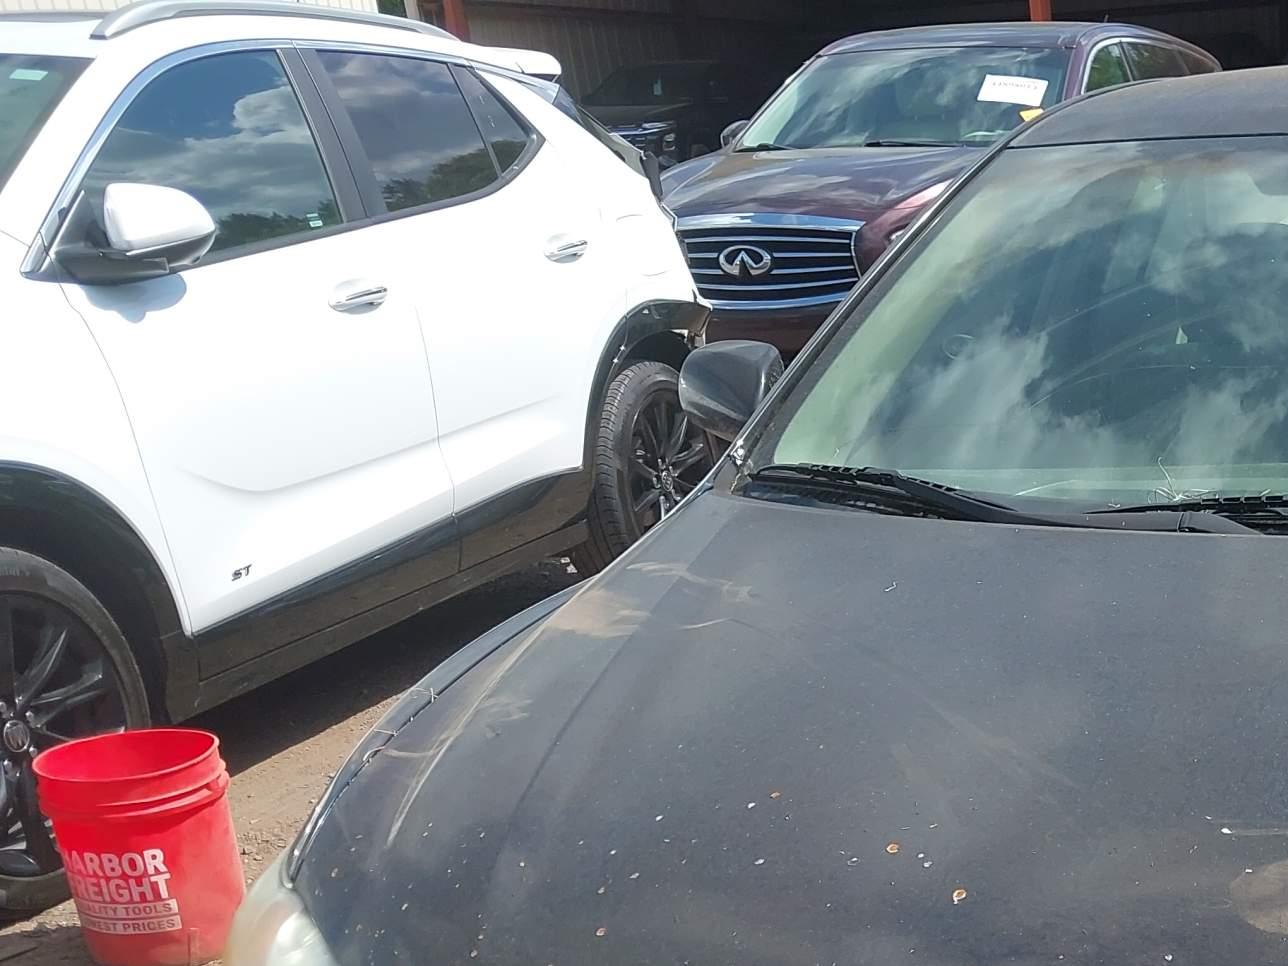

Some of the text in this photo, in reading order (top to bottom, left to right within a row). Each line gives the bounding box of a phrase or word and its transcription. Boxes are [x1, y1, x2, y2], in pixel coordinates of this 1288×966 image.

[231, 563, 253, 582] ST
[122, 902, 173, 917] TOOLS
[121, 918, 176, 933] PRICES
